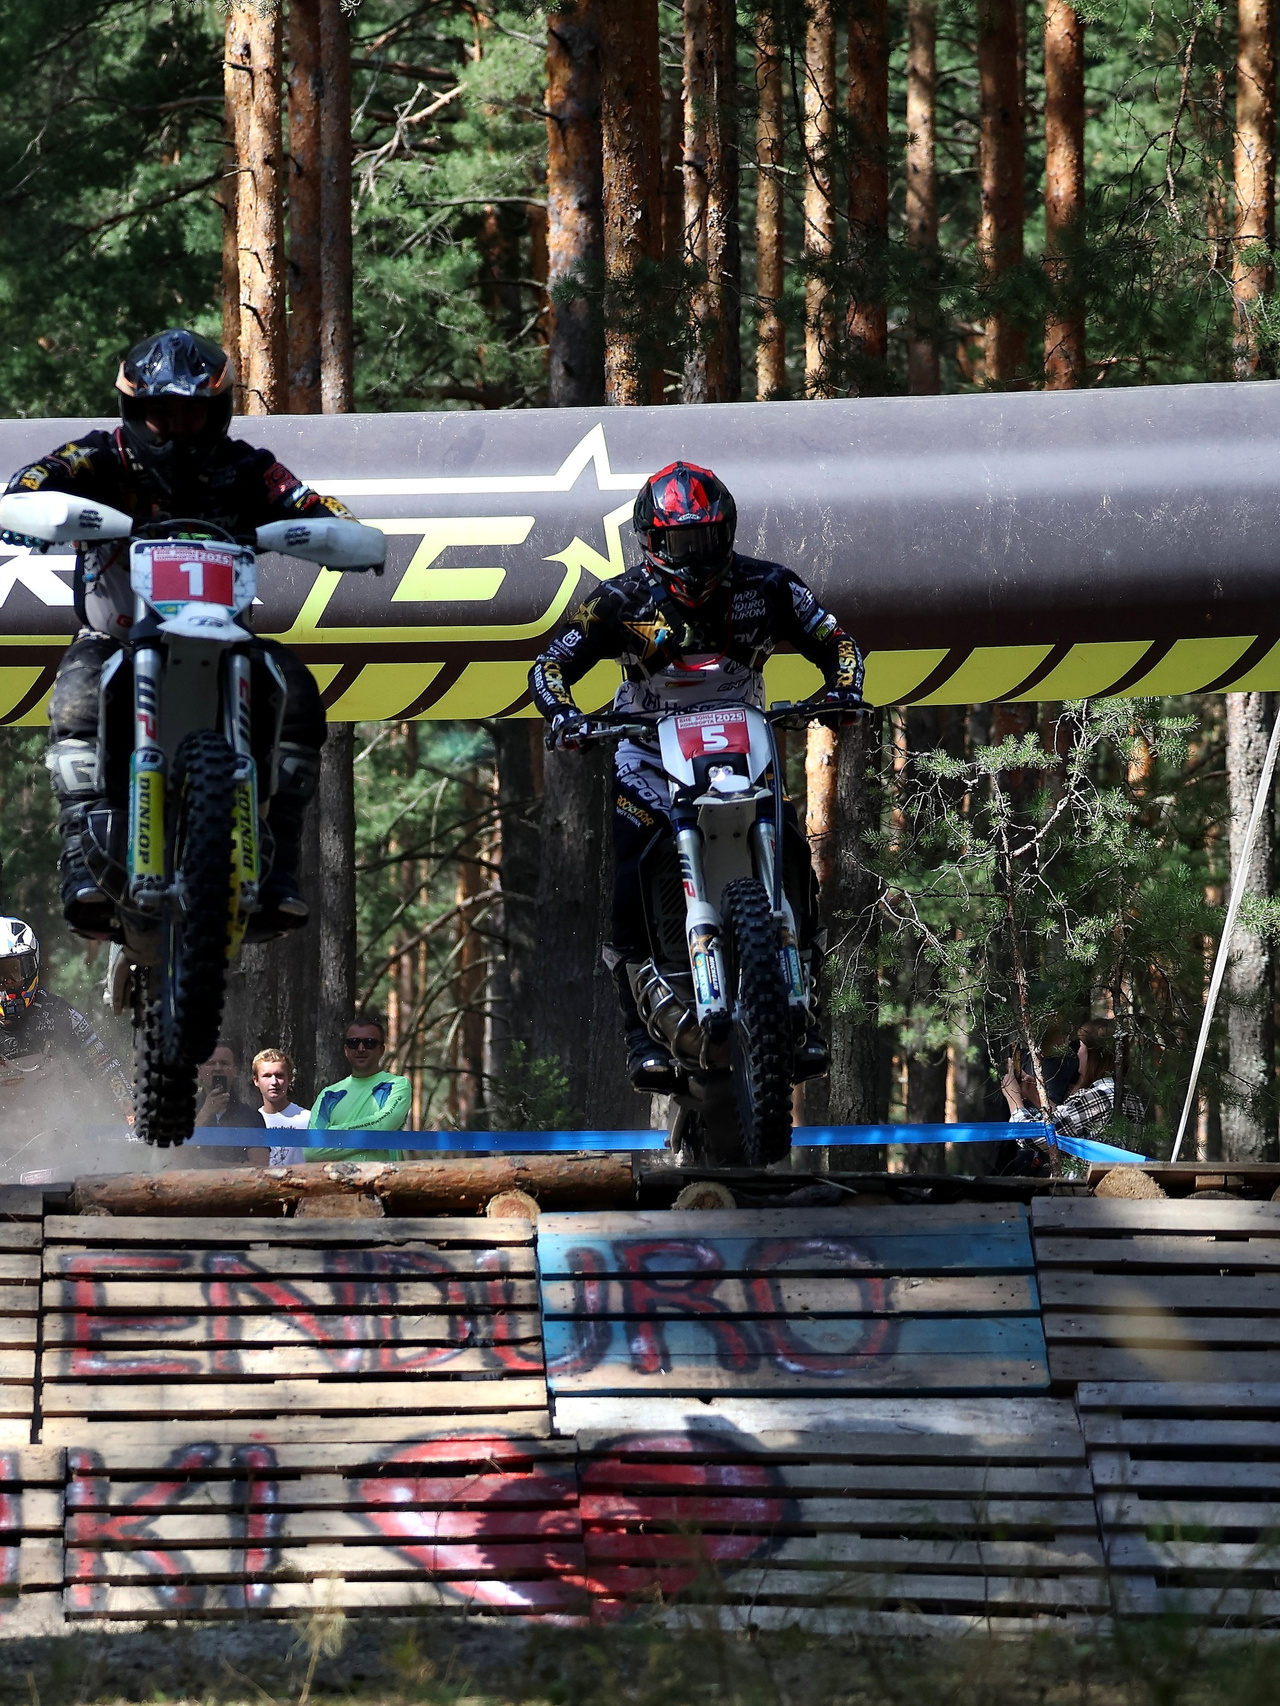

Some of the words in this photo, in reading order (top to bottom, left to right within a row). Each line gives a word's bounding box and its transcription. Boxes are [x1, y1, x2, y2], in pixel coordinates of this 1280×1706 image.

[179, 561, 204, 596] 1
[716, 712, 743, 722] 2025
[701, 725, 729, 751] 5
[138, 777, 151, 865] DUNLOP
[61, 1233, 900, 1377] ENDURO
